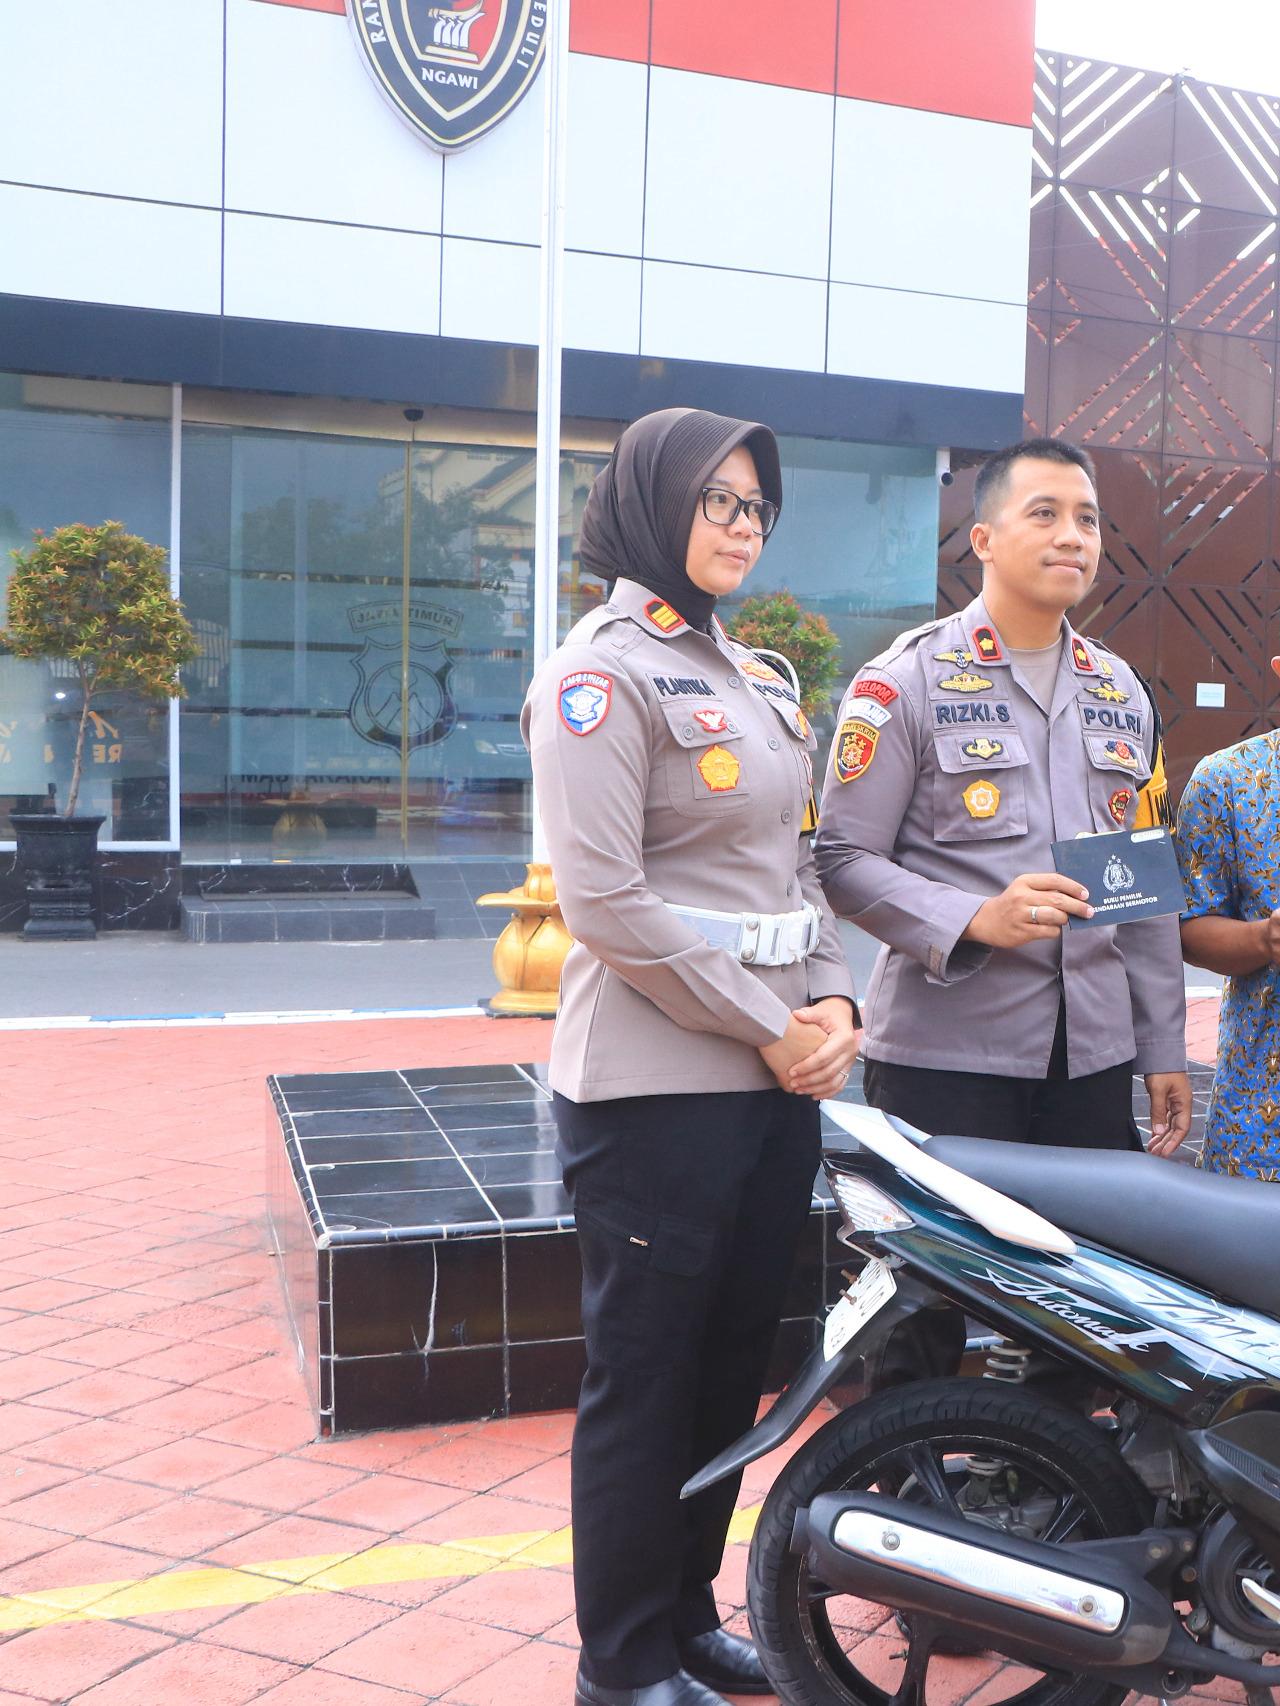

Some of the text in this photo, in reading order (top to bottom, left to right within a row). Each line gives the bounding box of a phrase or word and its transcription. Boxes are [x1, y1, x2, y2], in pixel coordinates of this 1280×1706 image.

[421, 67, 478, 89] NGAWI
[408, 607, 454, 627] TIMUR
[856, 681, 891, 700] PELOPOR
[936, 702, 1010, 725] RIZKI.S
[1084, 707, 1141, 734] POLRI
[1103, 896, 1119, 905] BUKU
[1126, 896, 1158, 907] BERMOTOR
